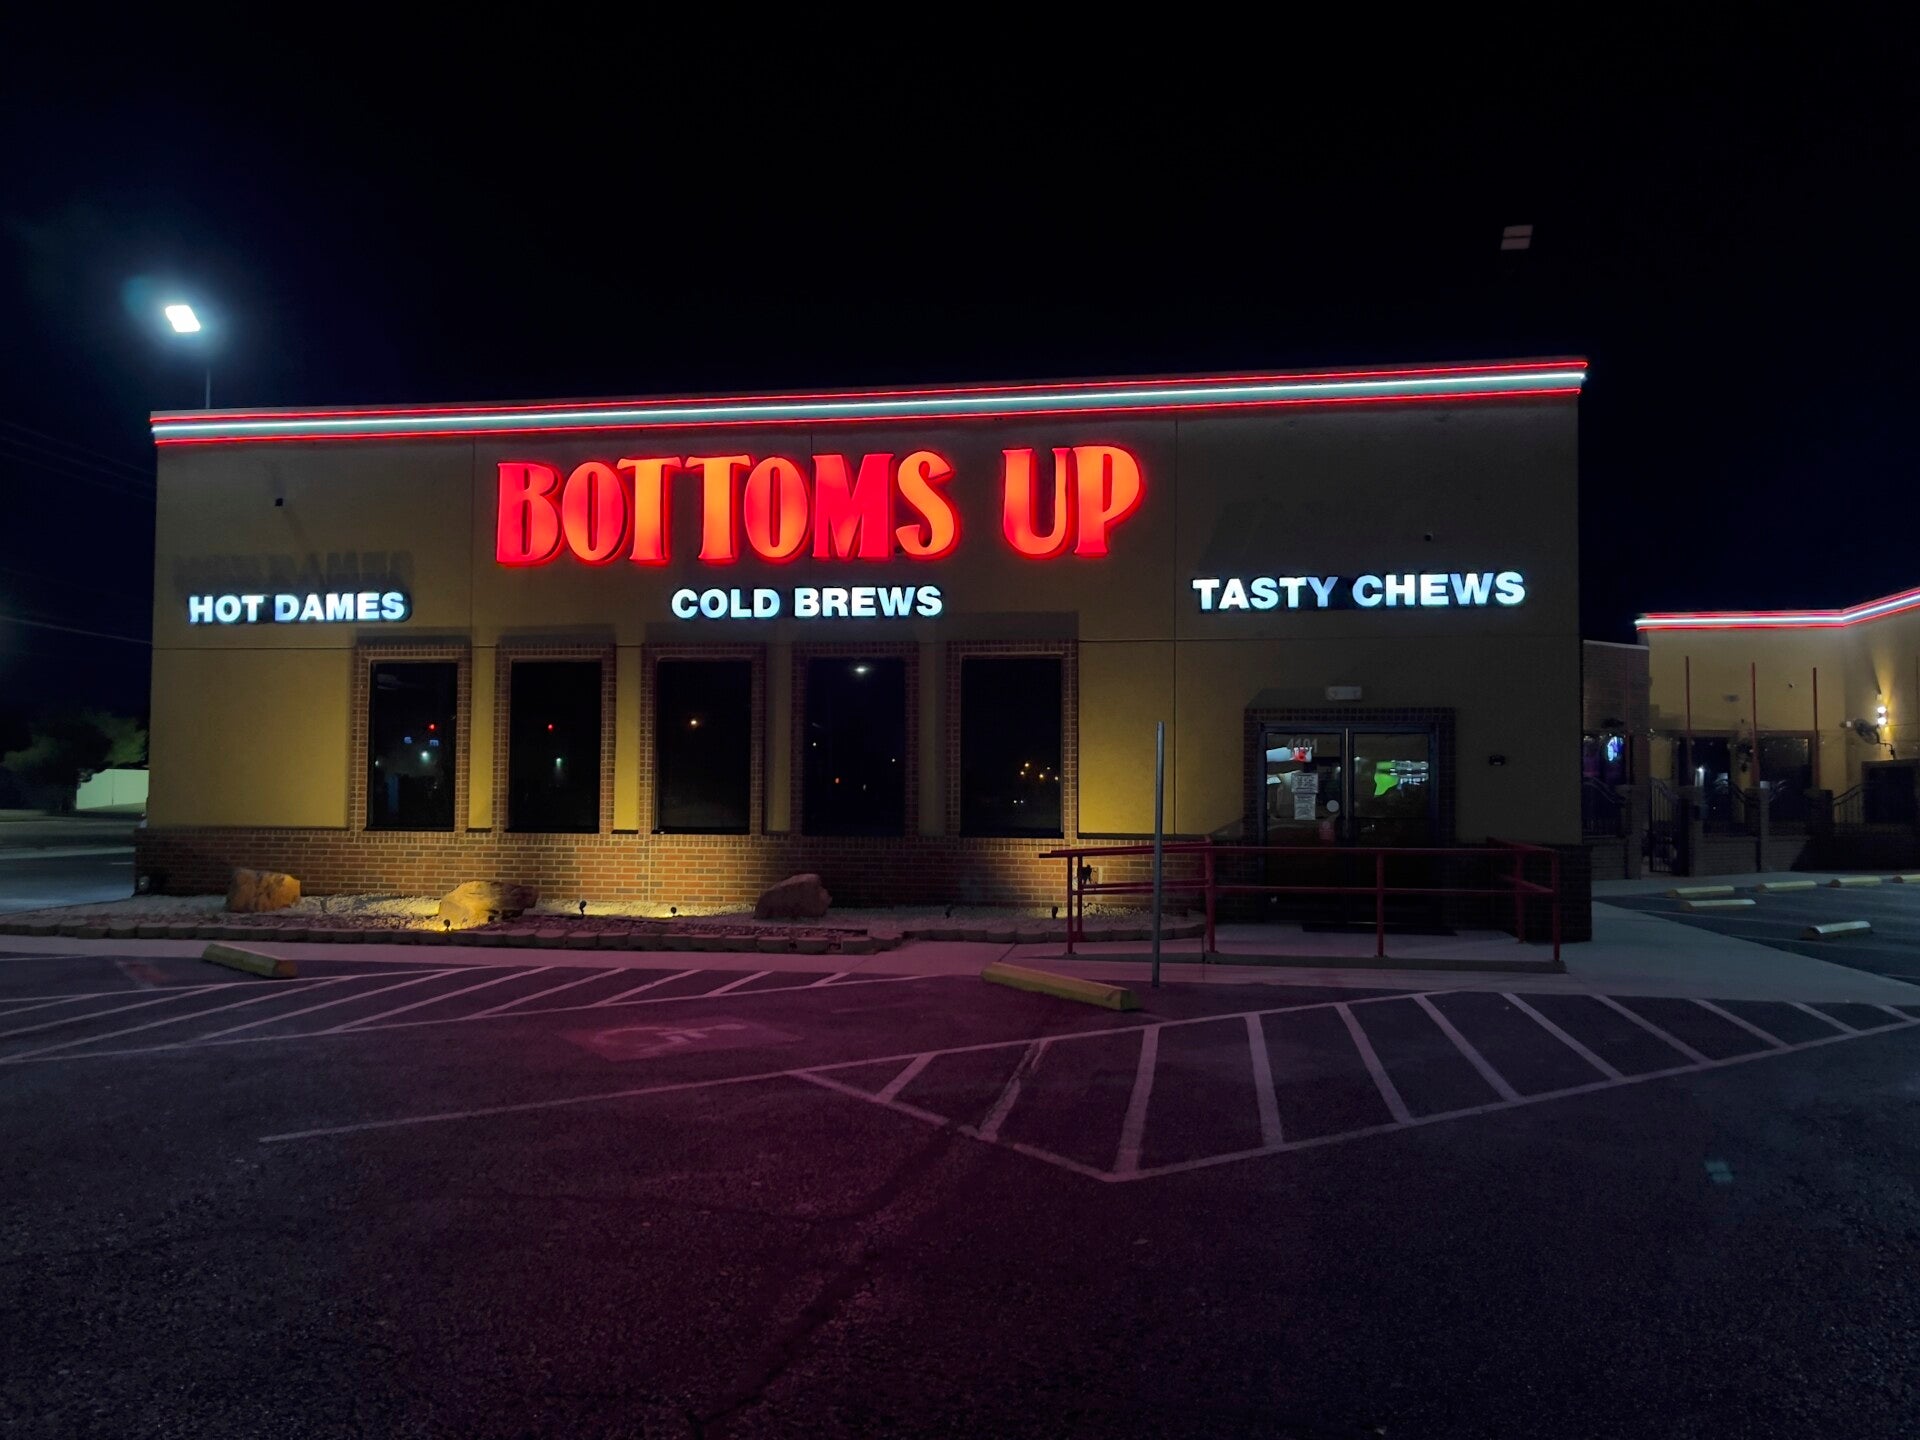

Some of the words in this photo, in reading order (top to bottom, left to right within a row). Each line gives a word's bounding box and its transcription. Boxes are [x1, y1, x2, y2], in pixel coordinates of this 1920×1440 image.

[496, 452, 959, 564] BOTTOMS
[1002, 446, 1144, 557] UP
[188, 595, 265, 624] HOT
[275, 592, 406, 622] DAMES
[670, 589, 780, 619] COLD
[794, 586, 943, 617] BREWS
[1192, 576, 1338, 610] TASTY
[1352, 572, 1526, 607] CHEWS
